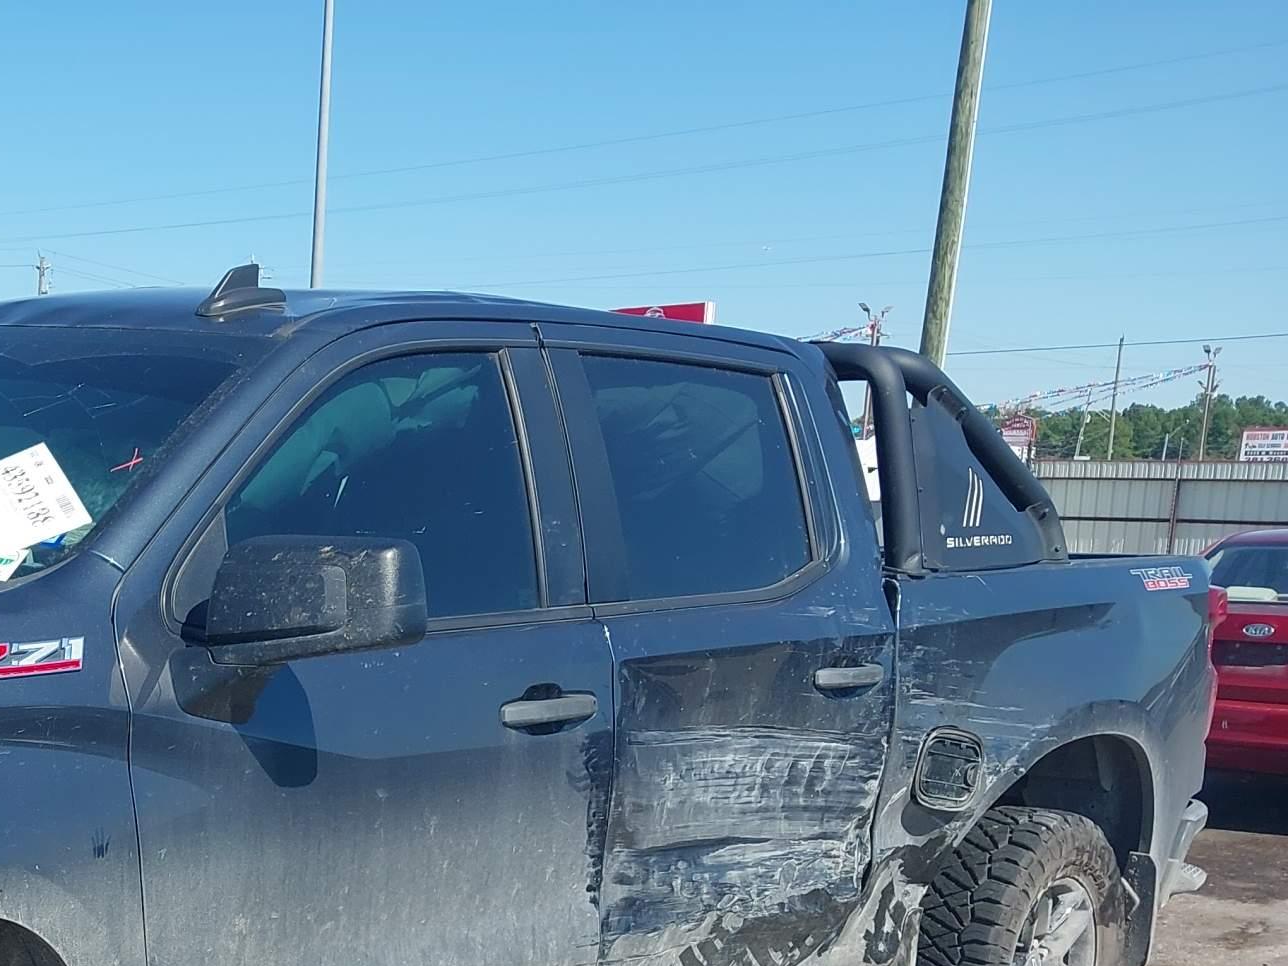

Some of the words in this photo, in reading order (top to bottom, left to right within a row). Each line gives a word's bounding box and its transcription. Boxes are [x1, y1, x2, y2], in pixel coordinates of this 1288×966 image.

[946, 534, 1013, 549] SILVERADO
[1130, 566, 1193, 581] TRAIL
[1144, 577, 1191, 591] BOSS
